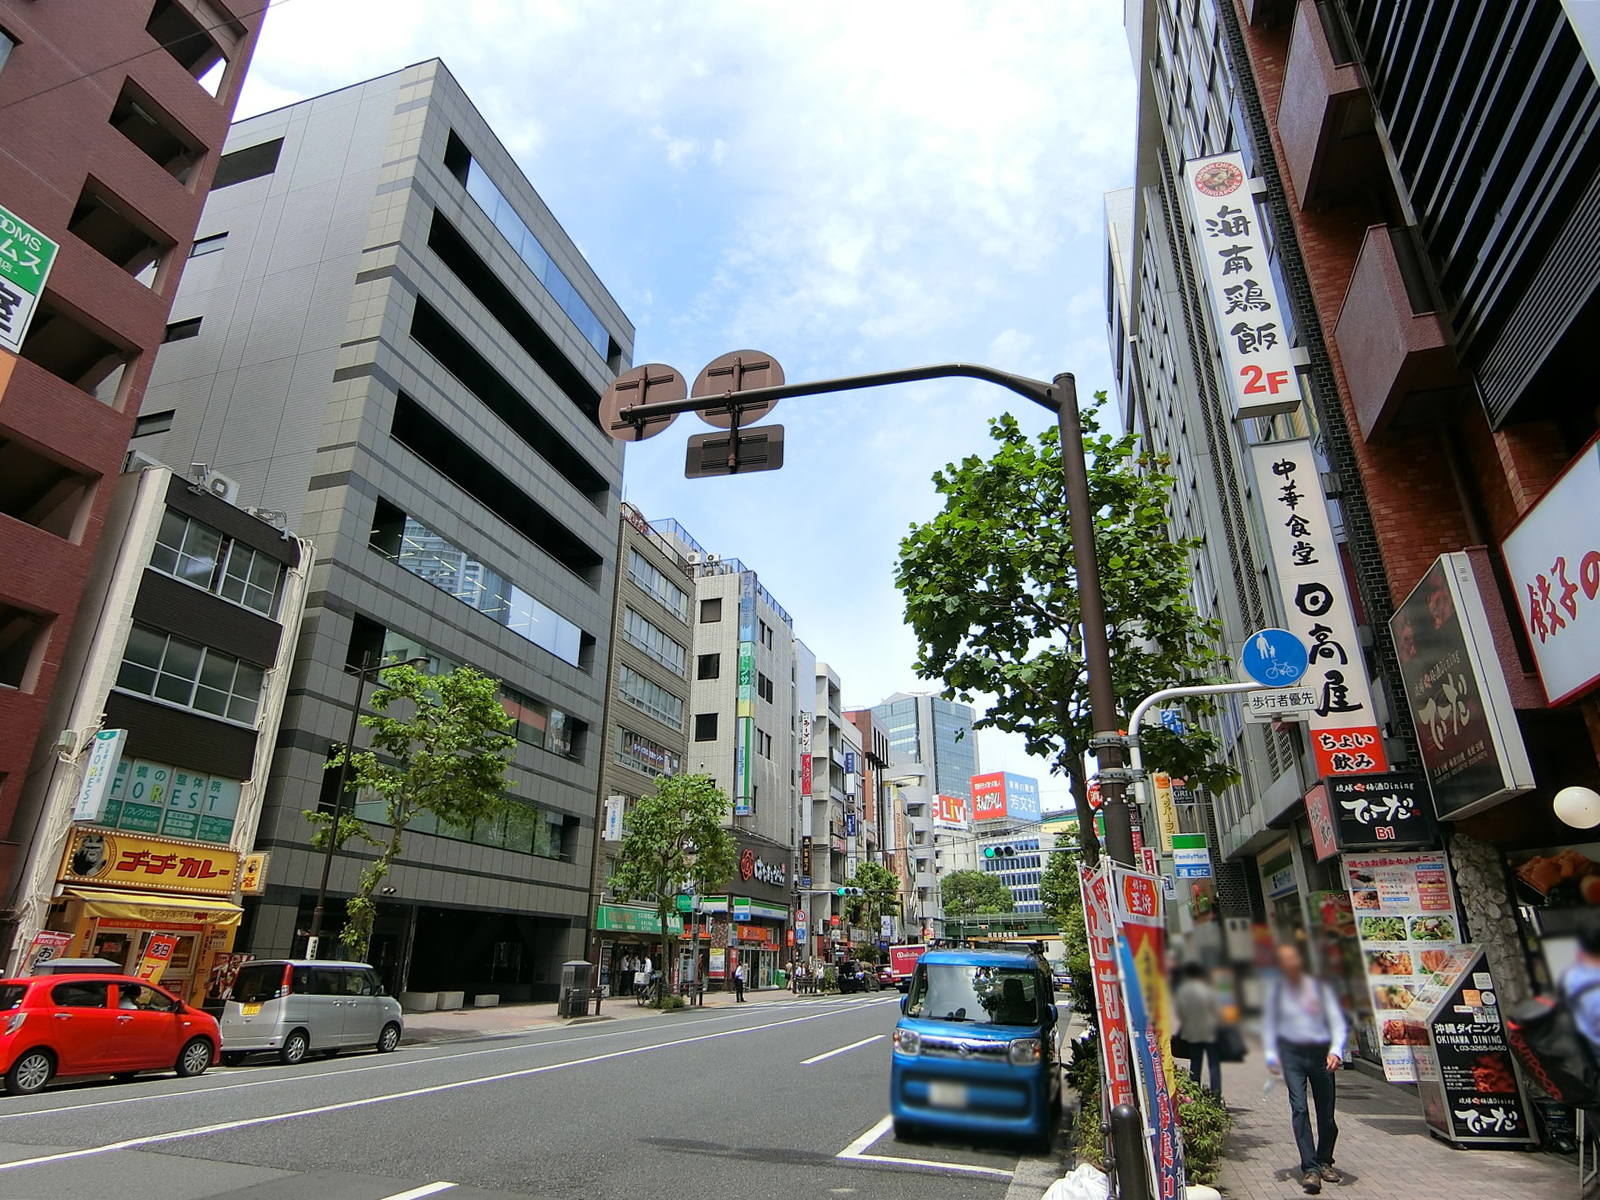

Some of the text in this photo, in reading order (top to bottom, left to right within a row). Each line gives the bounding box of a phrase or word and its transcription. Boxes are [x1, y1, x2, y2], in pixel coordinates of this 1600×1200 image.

[1200, 182, 1240, 197] SINGAPORE
[1205, 205, 1279, 355] 海南鶏飯
[1240, 365, 1289, 395] 2F
[1272, 457, 1319, 566] 中華食堂
[1294, 582, 1364, 717] 日高屋
[1253, 692, 1314, 709] 歩行者優先
[1319, 732, 1374, 750] ちょい
[1332, 752, 1375, 771] 飲み
[81, 742, 105, 812] FOREST
[110, 778, 218, 812] FOREST
[1010, 793, 1037, 813] 芳文社
[1340, 793, 1414, 825] てぃーだ
[1375, 826, 1395, 840] B1
[116, 850, 230, 879] ゴーゴーカレー
[1190, 868, 1208, 877] たばこ
[1131, 891, 1152, 914] 王将
[152, 942, 171, 957] 本日
[1434, 1023, 1501, 1034] 沖縄ダイニング
[1436, 1035, 1502, 1044] OKINAWA DINING
[1509, 1031, 1563, 1101] OUTDOOR
[1454, 1107, 1518, 1134] てぃーだ
